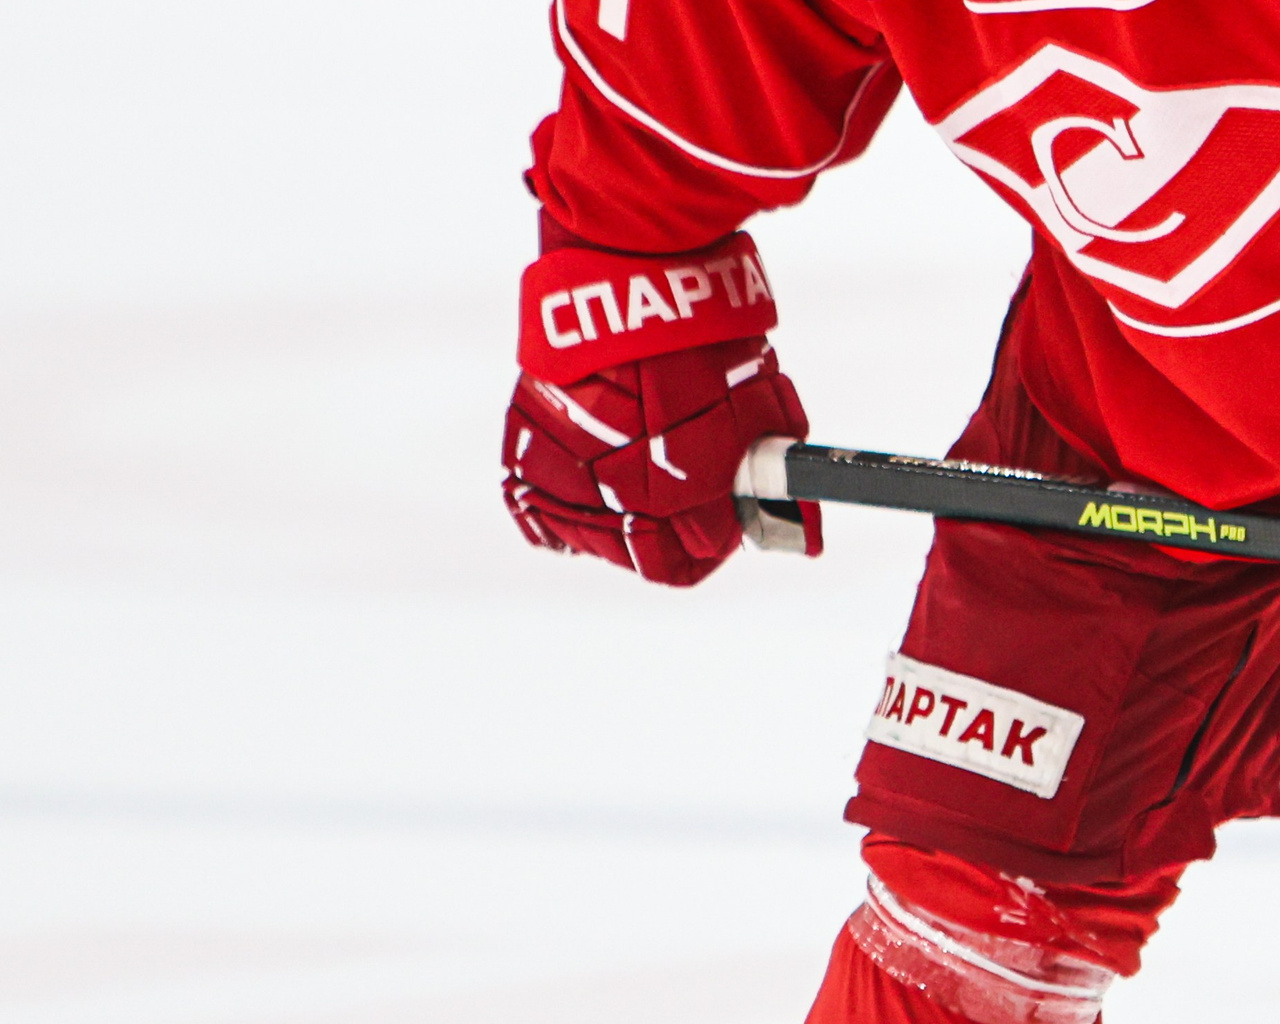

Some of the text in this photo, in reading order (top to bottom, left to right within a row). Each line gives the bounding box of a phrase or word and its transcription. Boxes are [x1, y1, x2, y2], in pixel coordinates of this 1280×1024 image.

[541, 252, 774, 349] СПАРТА
[1078, 501, 1246, 543] MORPH PRO
